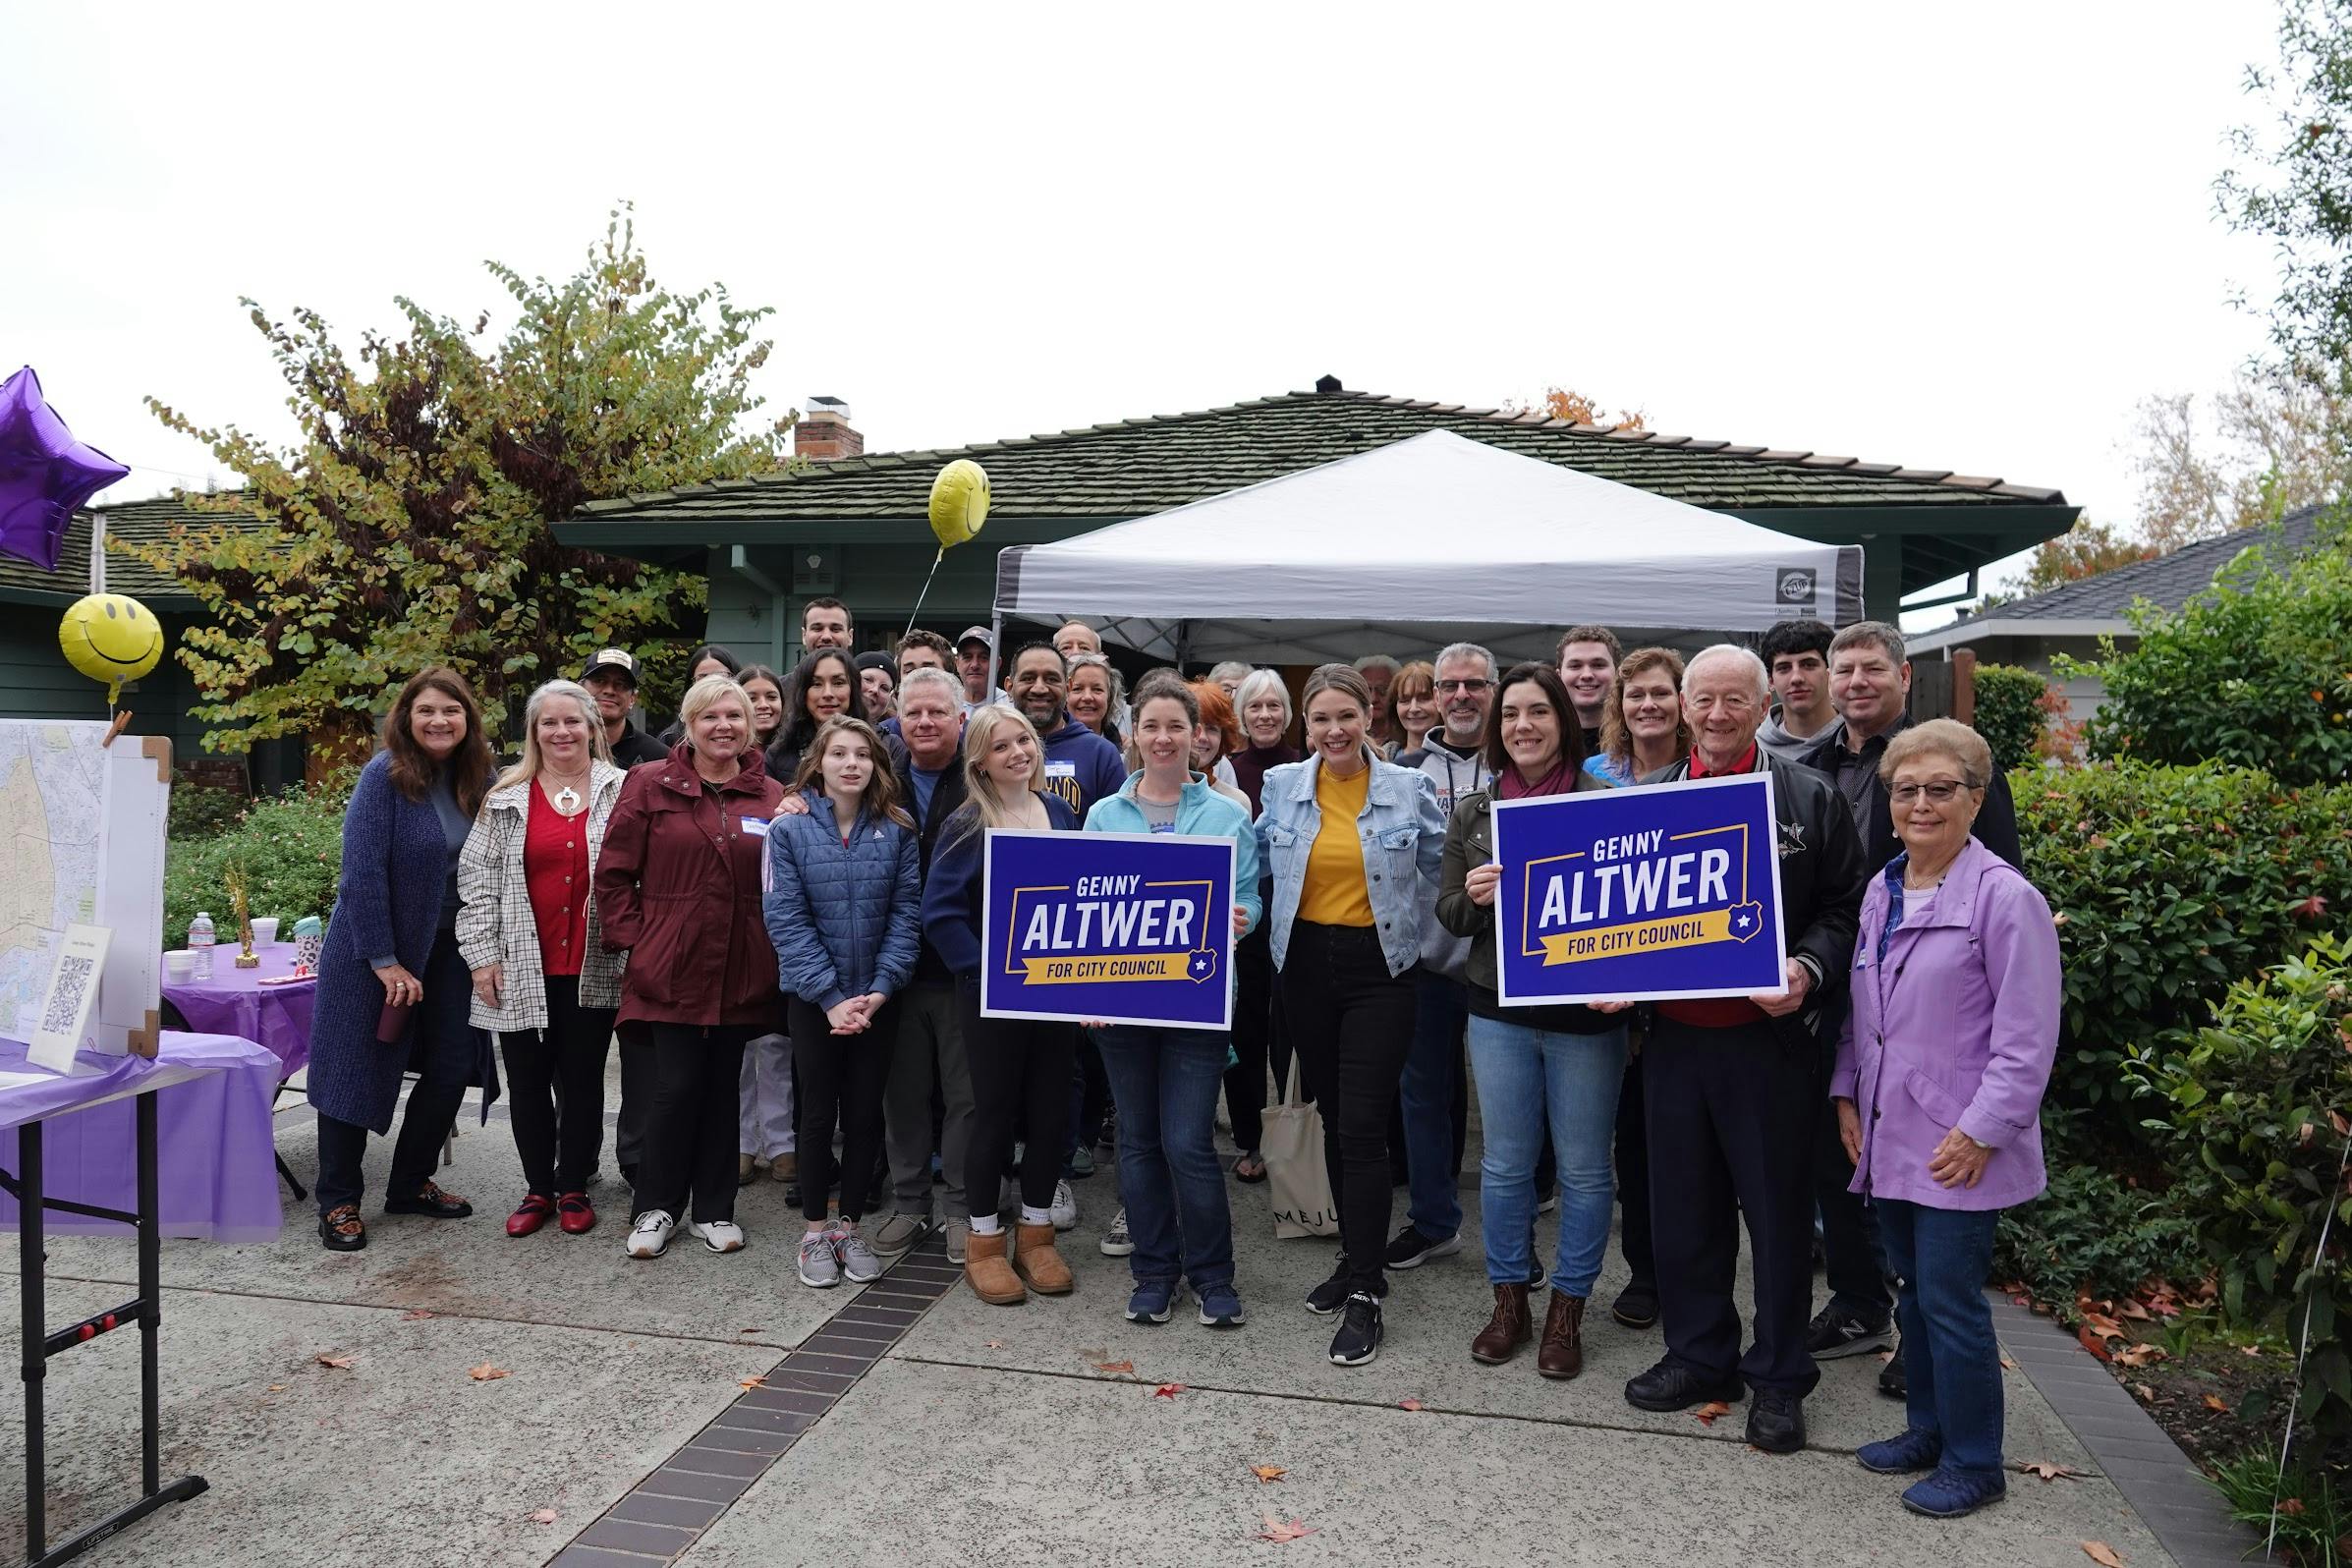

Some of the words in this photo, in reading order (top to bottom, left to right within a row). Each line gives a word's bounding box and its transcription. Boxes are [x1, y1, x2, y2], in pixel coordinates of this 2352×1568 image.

[1593, 829, 1664, 863] GENNY
[1076, 874, 1142, 897] GENNY
[1538, 848, 1730, 929] ALTWER
[1021, 898, 1195, 951] ALTWER
[1567, 937, 1596, 956] FOR
[1600, 930, 1635, 951] CITY
[1638, 921, 1705, 946] COUNCIL
[1046, 963, 1072, 979] FOR
[1077, 961, 1107, 978] CITY
[1109, 960, 1167, 976] COUNCIL
